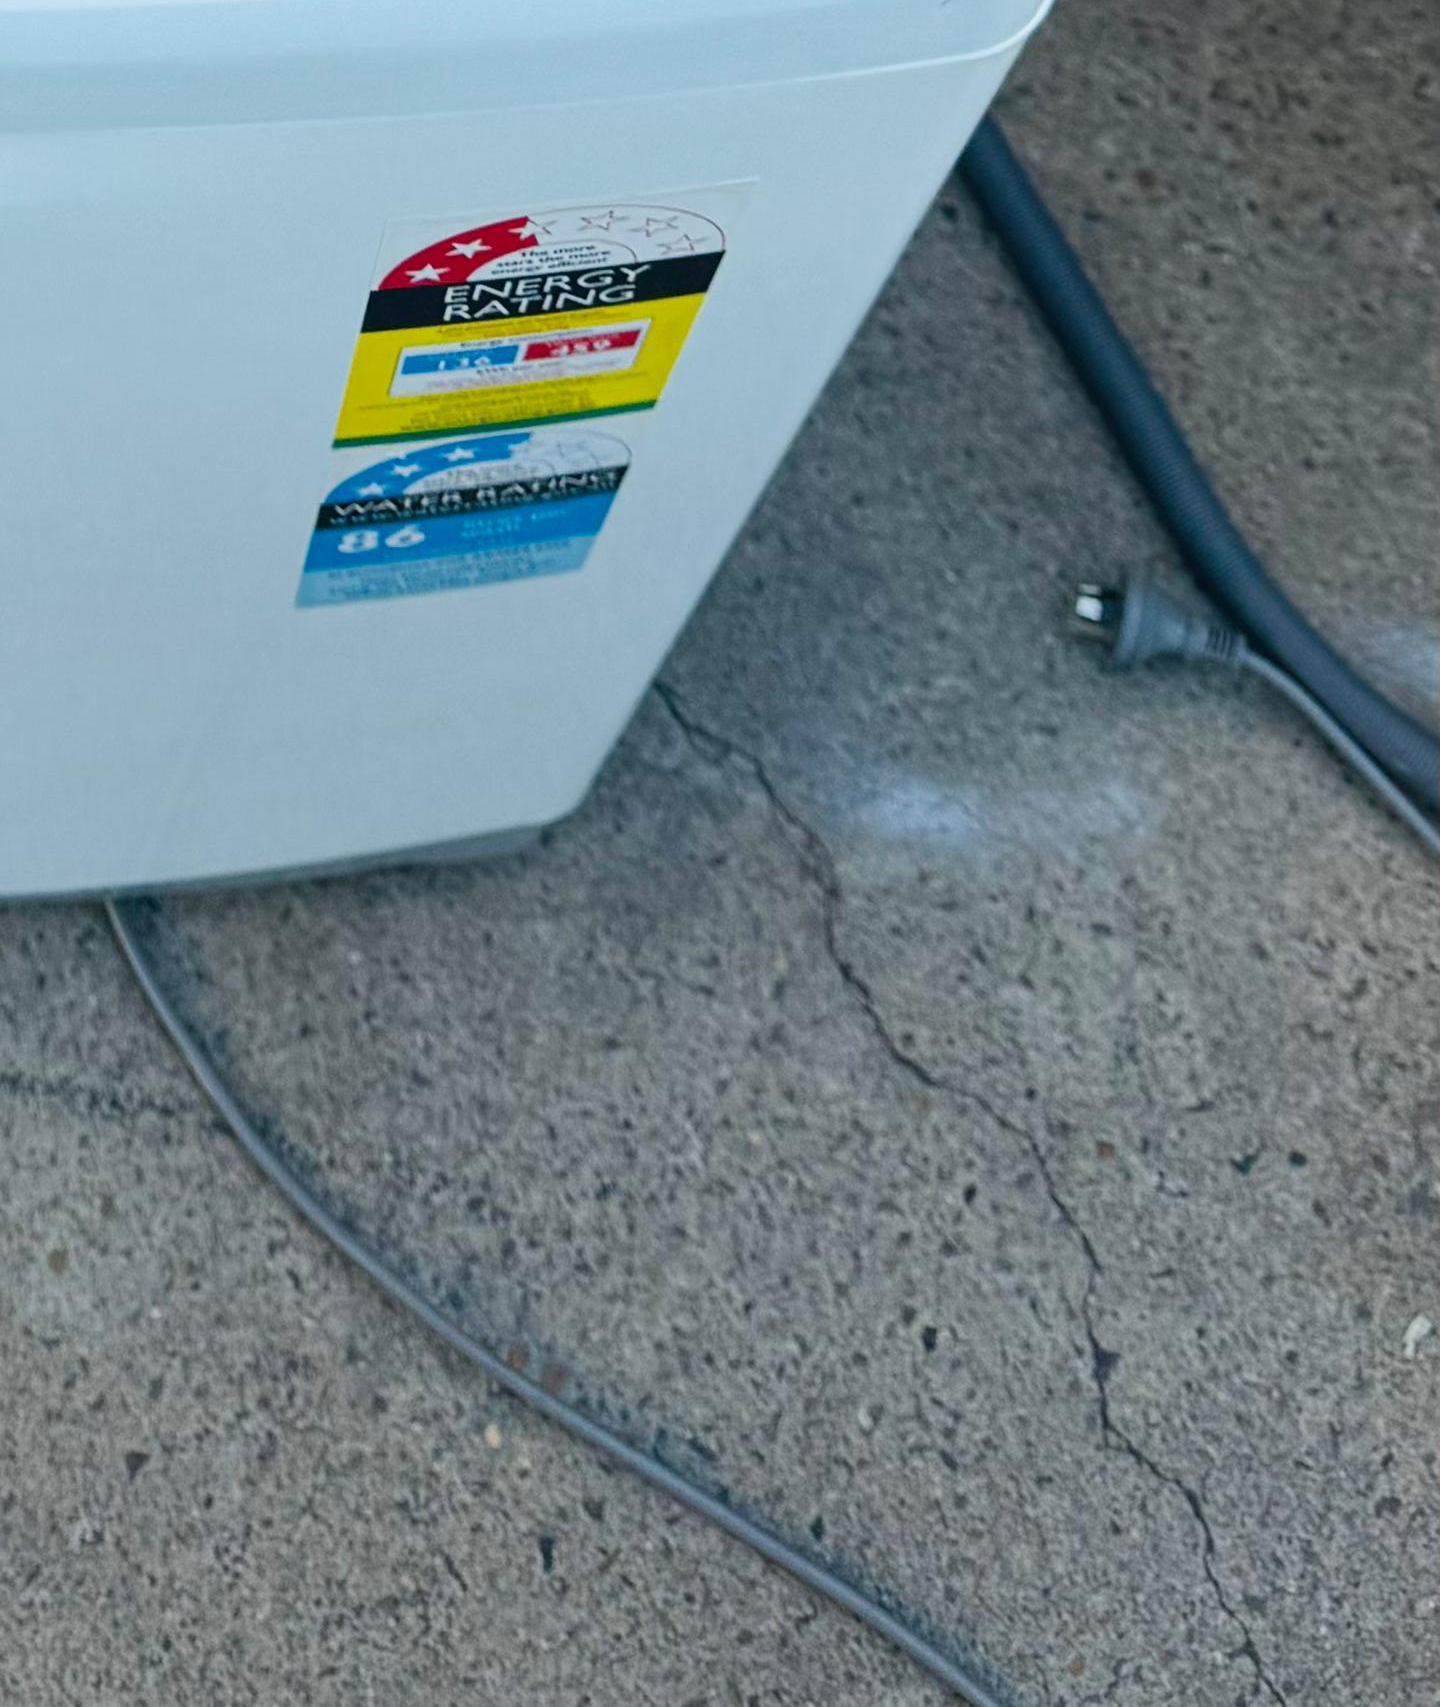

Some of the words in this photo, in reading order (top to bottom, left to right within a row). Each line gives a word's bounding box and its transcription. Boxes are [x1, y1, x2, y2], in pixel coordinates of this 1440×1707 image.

[442, 284, 637, 322] RATING
[444, 264, 651, 304] ENERGY
[337, 524, 426, 554] 86
